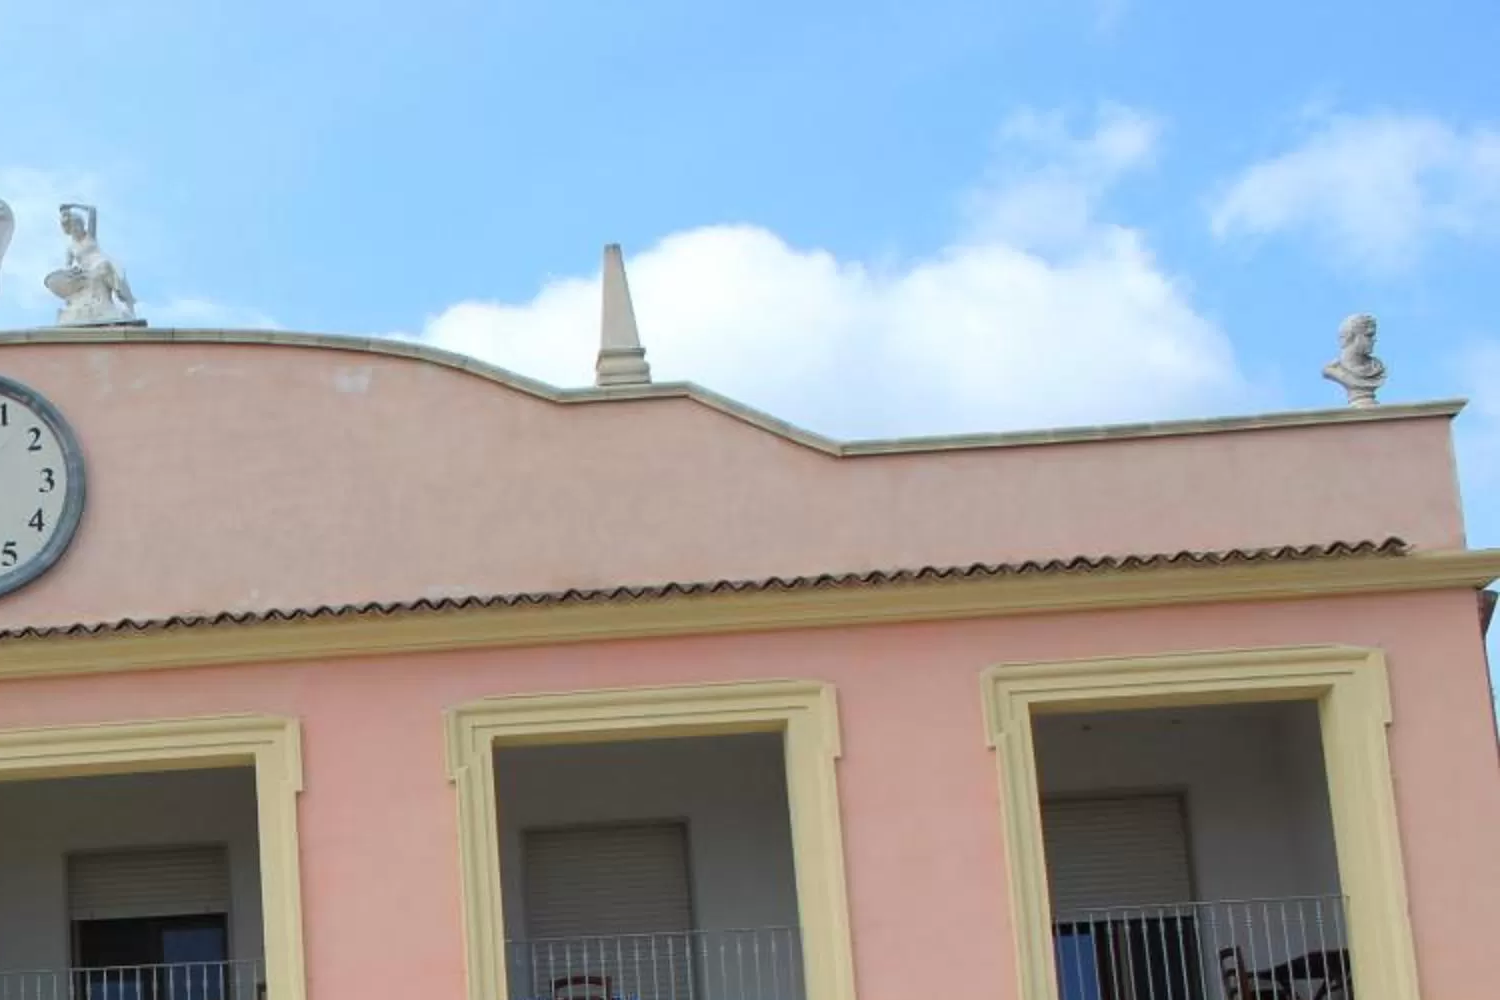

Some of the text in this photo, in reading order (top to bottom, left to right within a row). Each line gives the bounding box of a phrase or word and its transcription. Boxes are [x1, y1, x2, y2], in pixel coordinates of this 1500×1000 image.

[0, 403, 9, 426] 1
[28, 427, 42, 451] 2
[38, 468, 55, 493] 3
[28, 508, 45, 532] 4
[1, 541, 18, 567] 5
